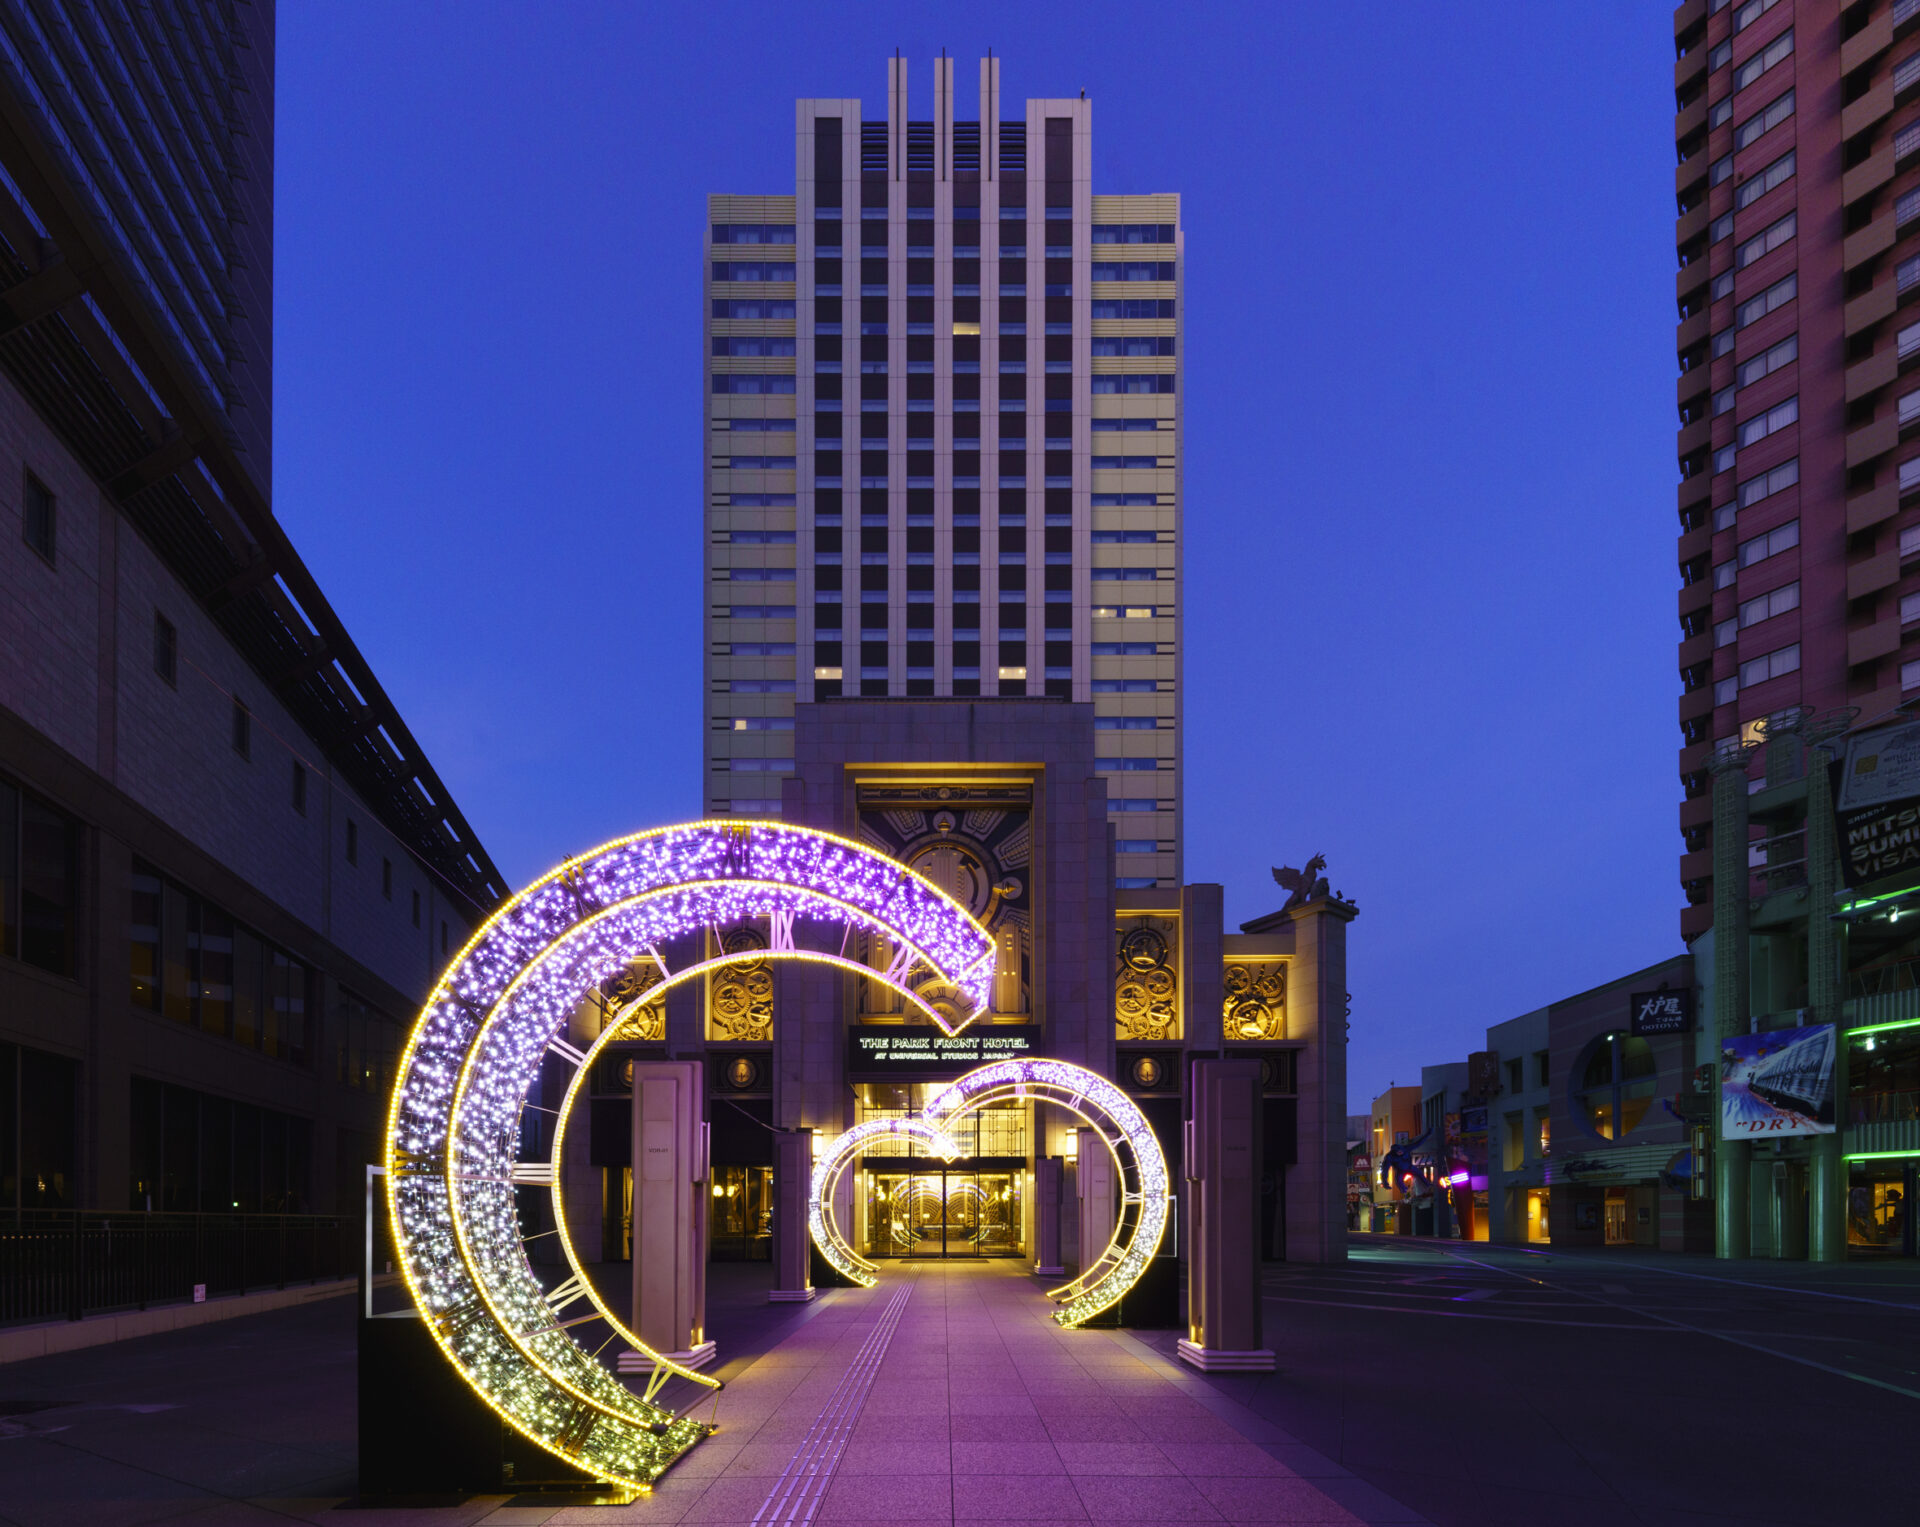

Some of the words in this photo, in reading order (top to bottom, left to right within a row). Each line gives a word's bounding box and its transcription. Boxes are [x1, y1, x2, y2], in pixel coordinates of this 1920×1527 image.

[1848, 805, 1920, 845] MITS
[1638, 996, 1683, 1021] 大戸屋
[1640, 1022, 1680, 1031] OOTOYA
[859, 1037, 889, 1049] THE
[892, 1037, 930, 1049] PARK
[934, 1037, 980, 1049] FRONT
[983, 1037, 1029, 1049] HOTEL
[874, 1052, 887, 1060] AT
[889, 1052, 939, 1060] UNIVERSAL
[941, 1052, 978, 1060] STUDIOS
